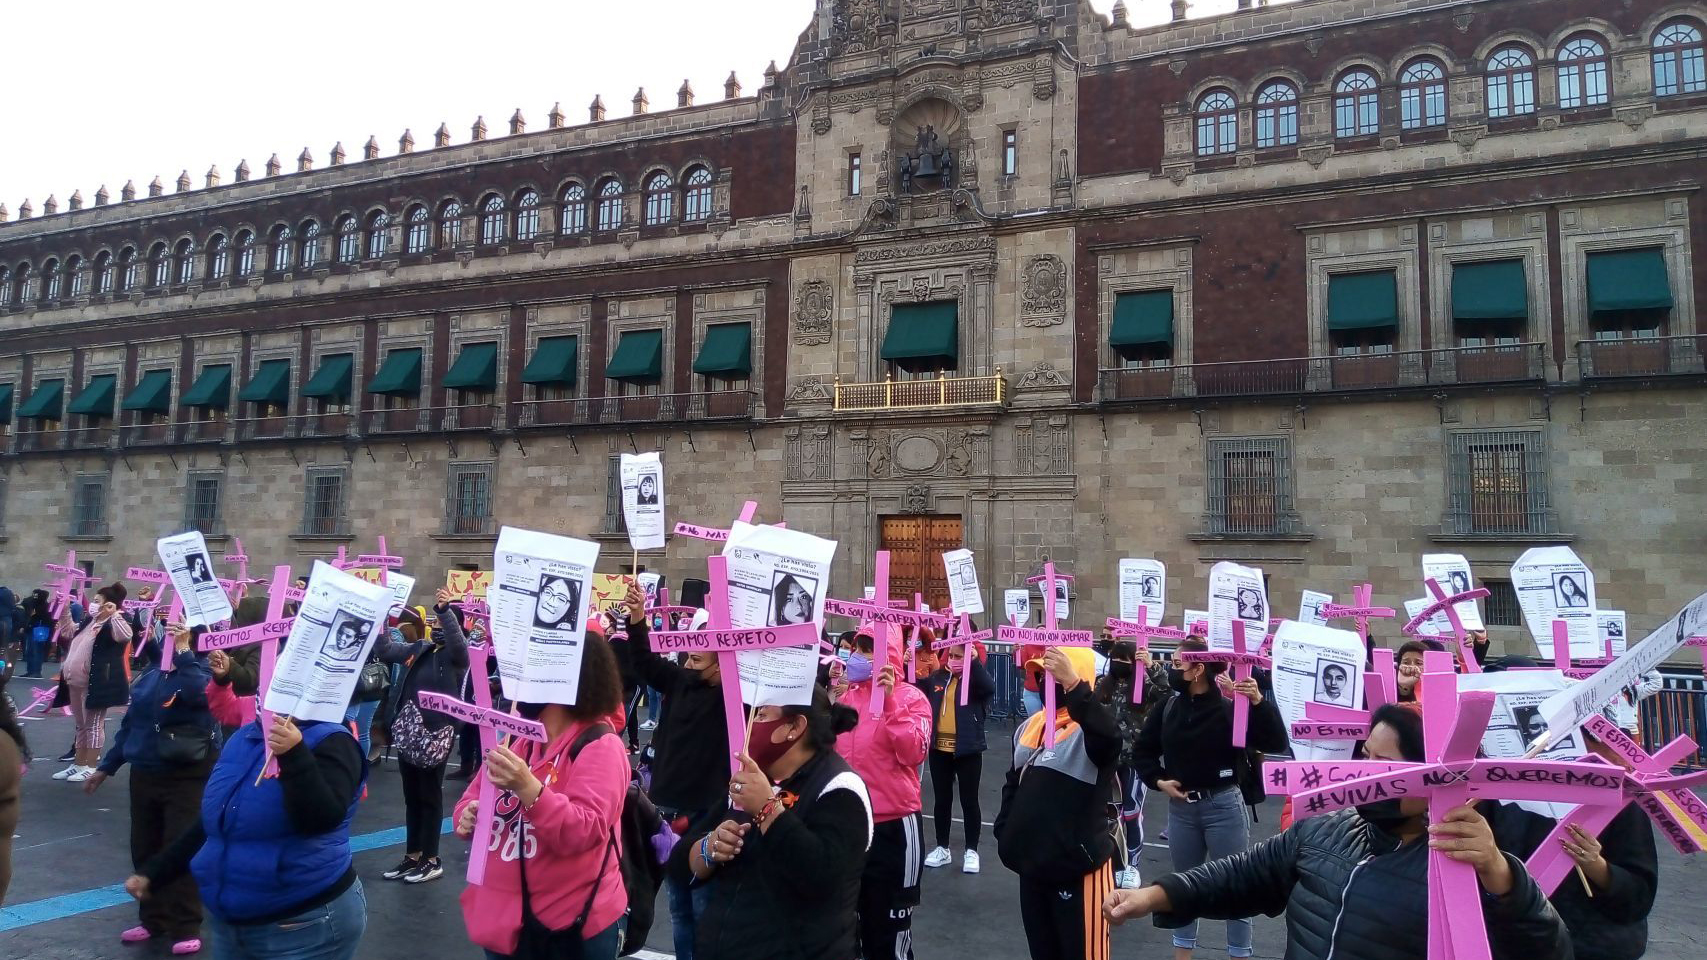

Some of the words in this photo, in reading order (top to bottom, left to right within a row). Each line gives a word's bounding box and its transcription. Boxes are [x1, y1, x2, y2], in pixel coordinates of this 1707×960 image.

[678, 525, 699, 536] #No
[848, 606, 864, 618] SOY
[205, 631, 252, 647] PEDIMOS
[263, 618, 293, 635] RESPE
[657, 633, 710, 649] PEDIMOS
[716, 631, 777, 648] RESPETO
[1060, 633, 1090, 643] QUEMAR
[1294, 725, 1311, 737] NO
[1317, 725, 1332, 736] ES
[1605, 729, 1645, 763] ESTADO
[1304, 779, 1408, 812] #VIVAS
[1486, 766, 1620, 789] QUEREMOS
